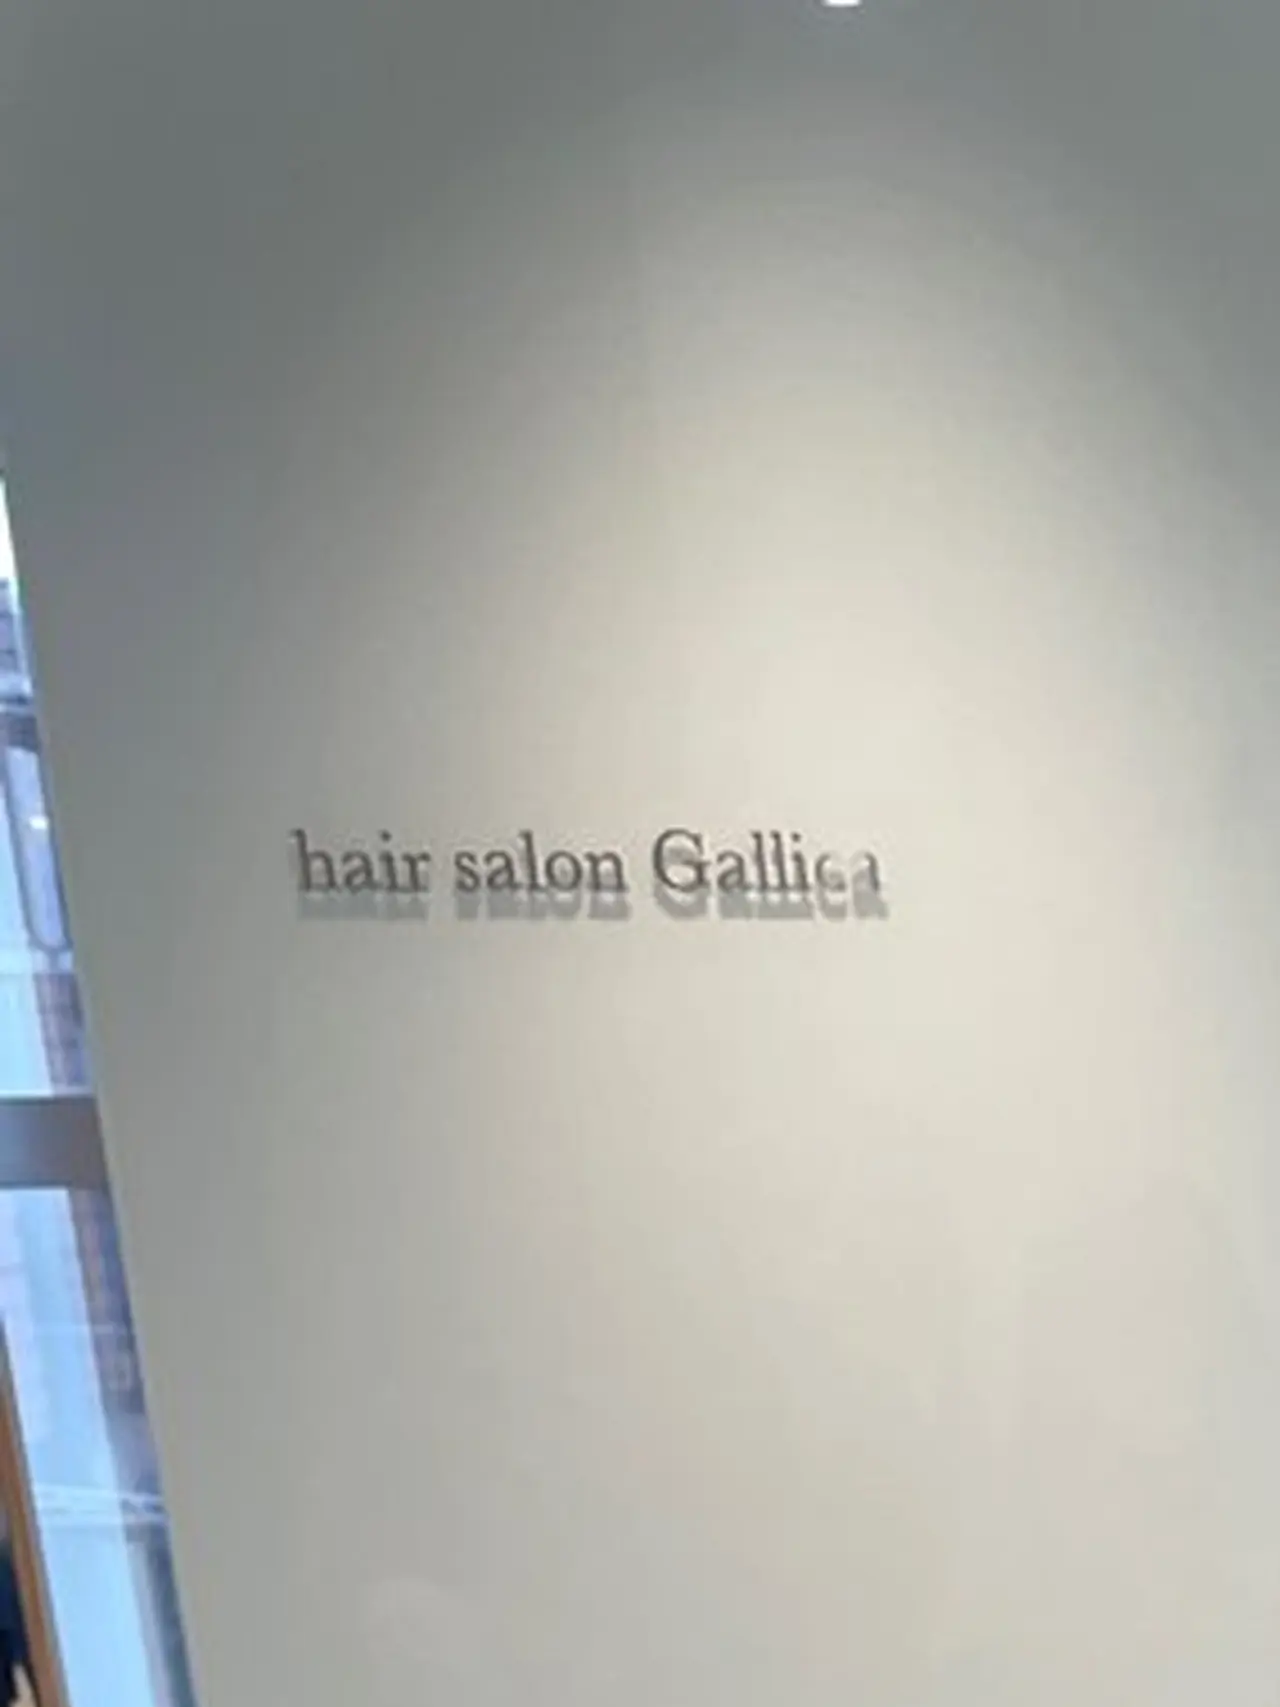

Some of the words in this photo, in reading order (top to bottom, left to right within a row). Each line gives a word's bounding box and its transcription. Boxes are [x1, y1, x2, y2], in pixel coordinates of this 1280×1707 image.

[291, 829, 432, 893] hair
[453, 831, 632, 893] salon
[652, 828, 882, 893] Gallica
